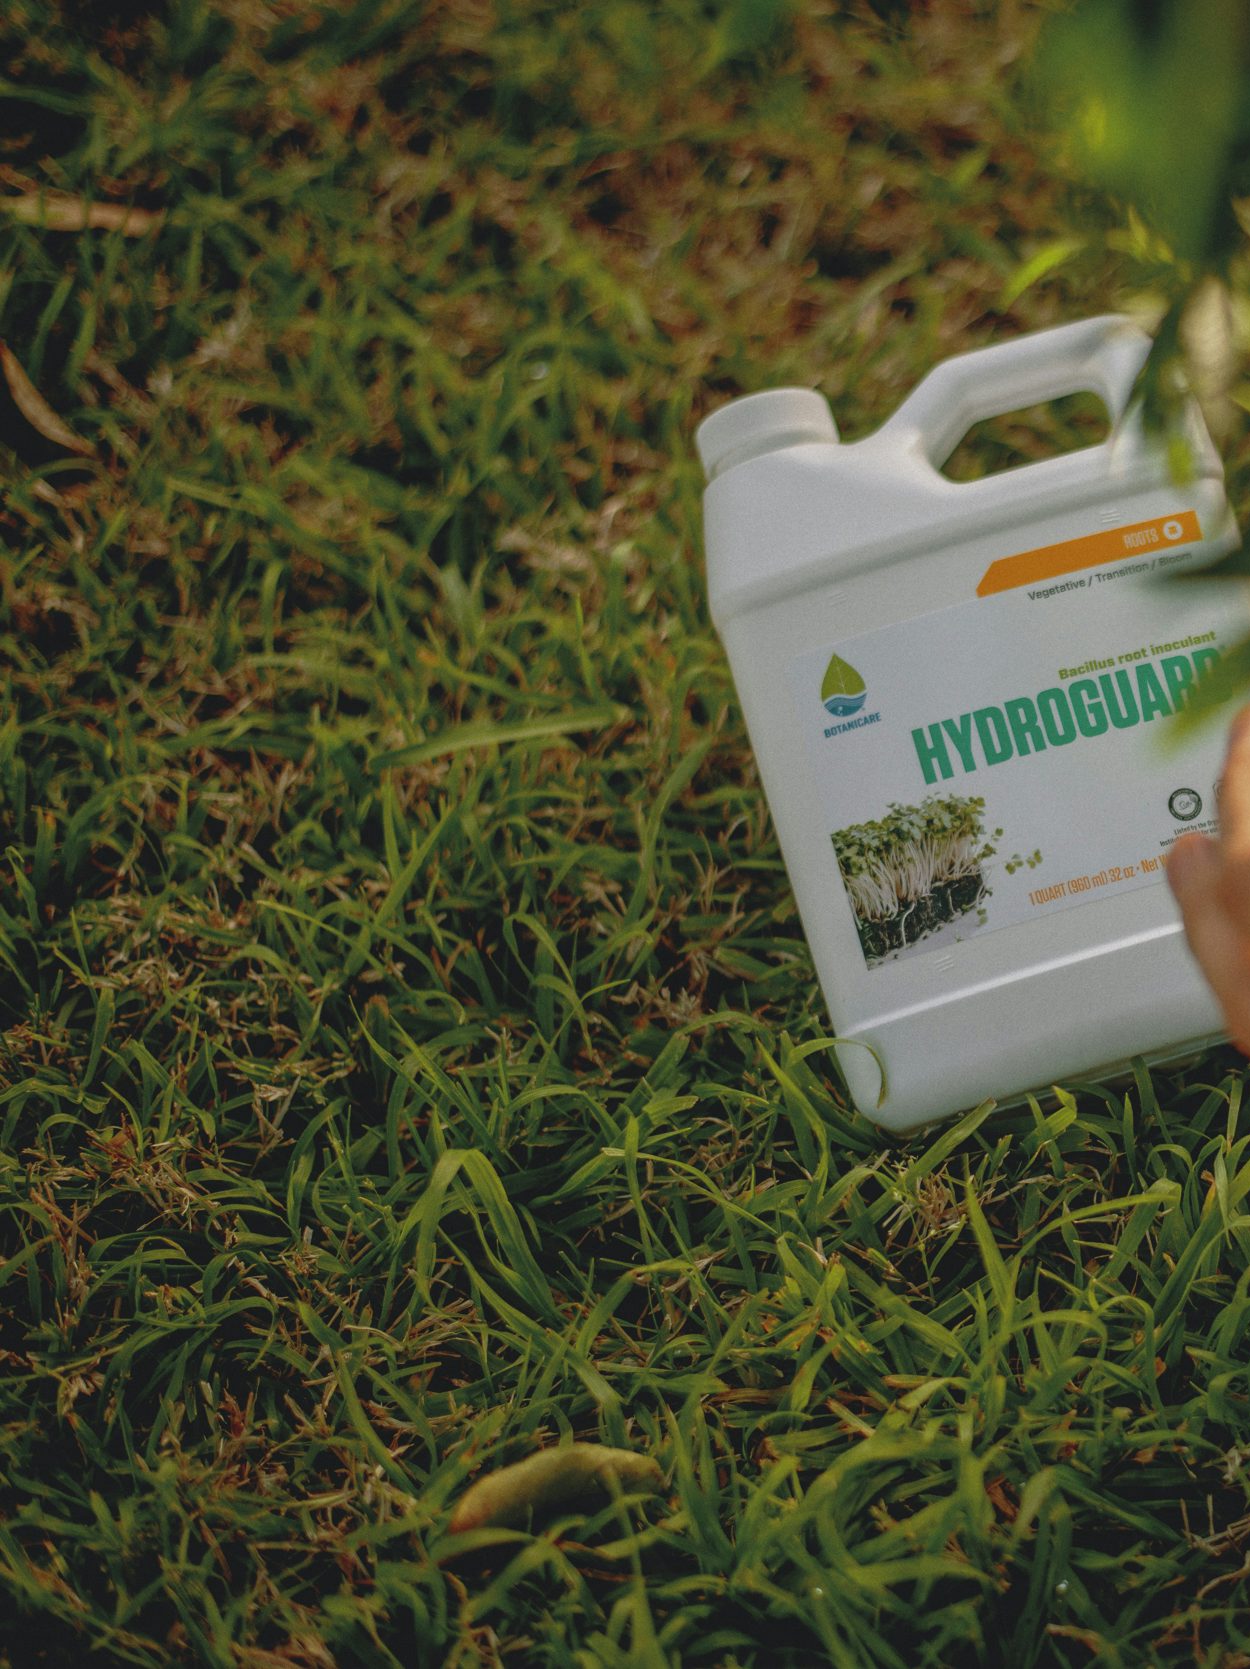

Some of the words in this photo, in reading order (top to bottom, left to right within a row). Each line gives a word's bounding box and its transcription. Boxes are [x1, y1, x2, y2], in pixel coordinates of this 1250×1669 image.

[1123, 528, 1159, 549] ROOTS
[1028, 580, 1086, 600] Vegetative
[1095, 563, 1151, 584] Transition
[1158, 552, 1192, 567] Bloom
[1058, 656, 1115, 680] Bacillus
[1118, 649, 1148, 665] root
[1150, 631, 1217, 656] inoculant
[823, 711, 882, 739] BOTANICARE
[1036, 883, 1067, 905] QUART
[1067, 876, 1091, 895] (960
[1109, 867, 1123, 883] 32
[1123, 866, 1136, 879] oz
[1141, 858, 1159, 873] Net
